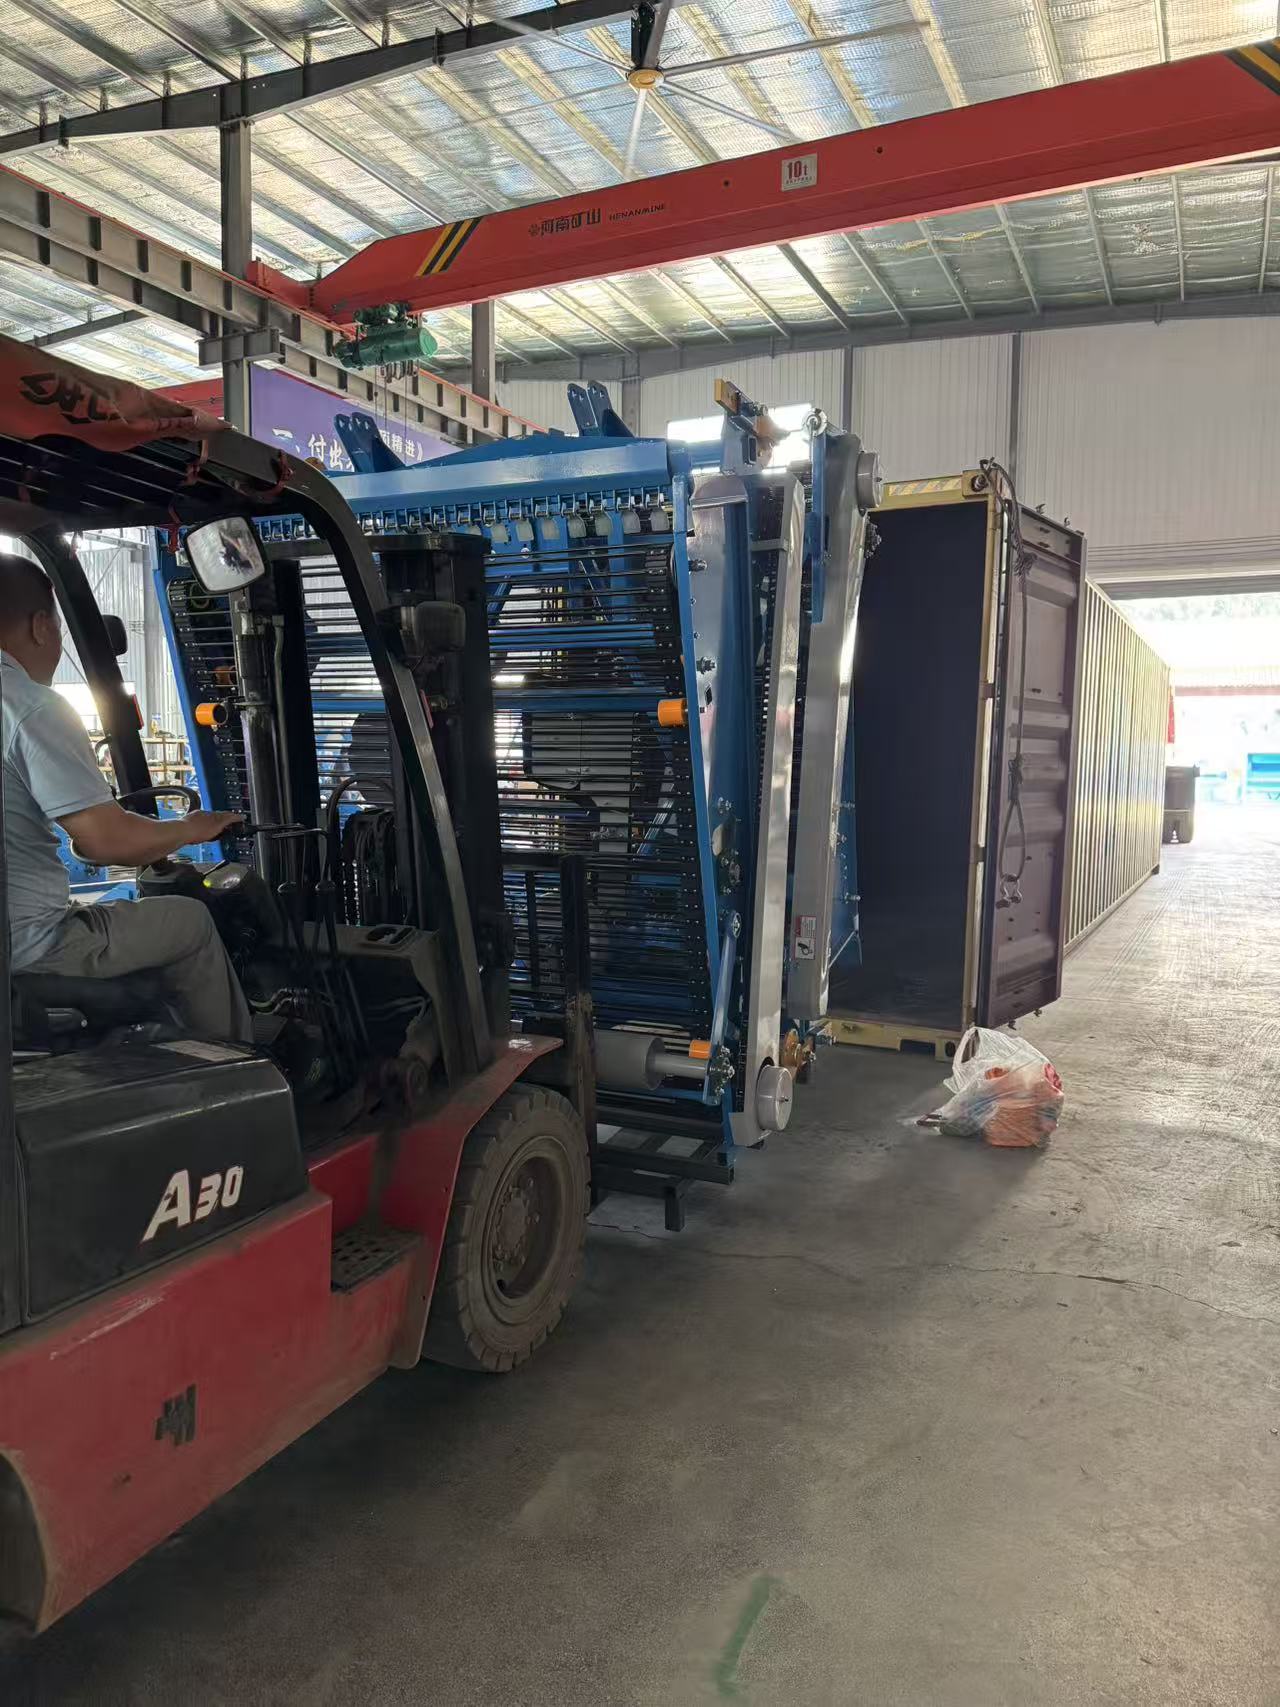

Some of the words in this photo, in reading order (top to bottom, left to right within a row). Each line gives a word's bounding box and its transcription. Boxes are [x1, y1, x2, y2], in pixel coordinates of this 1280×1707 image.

[788, 160, 808, 179] 10t
[540, 207, 601, 236] 河南矿山
[141, 1165, 244, 1242] A30
